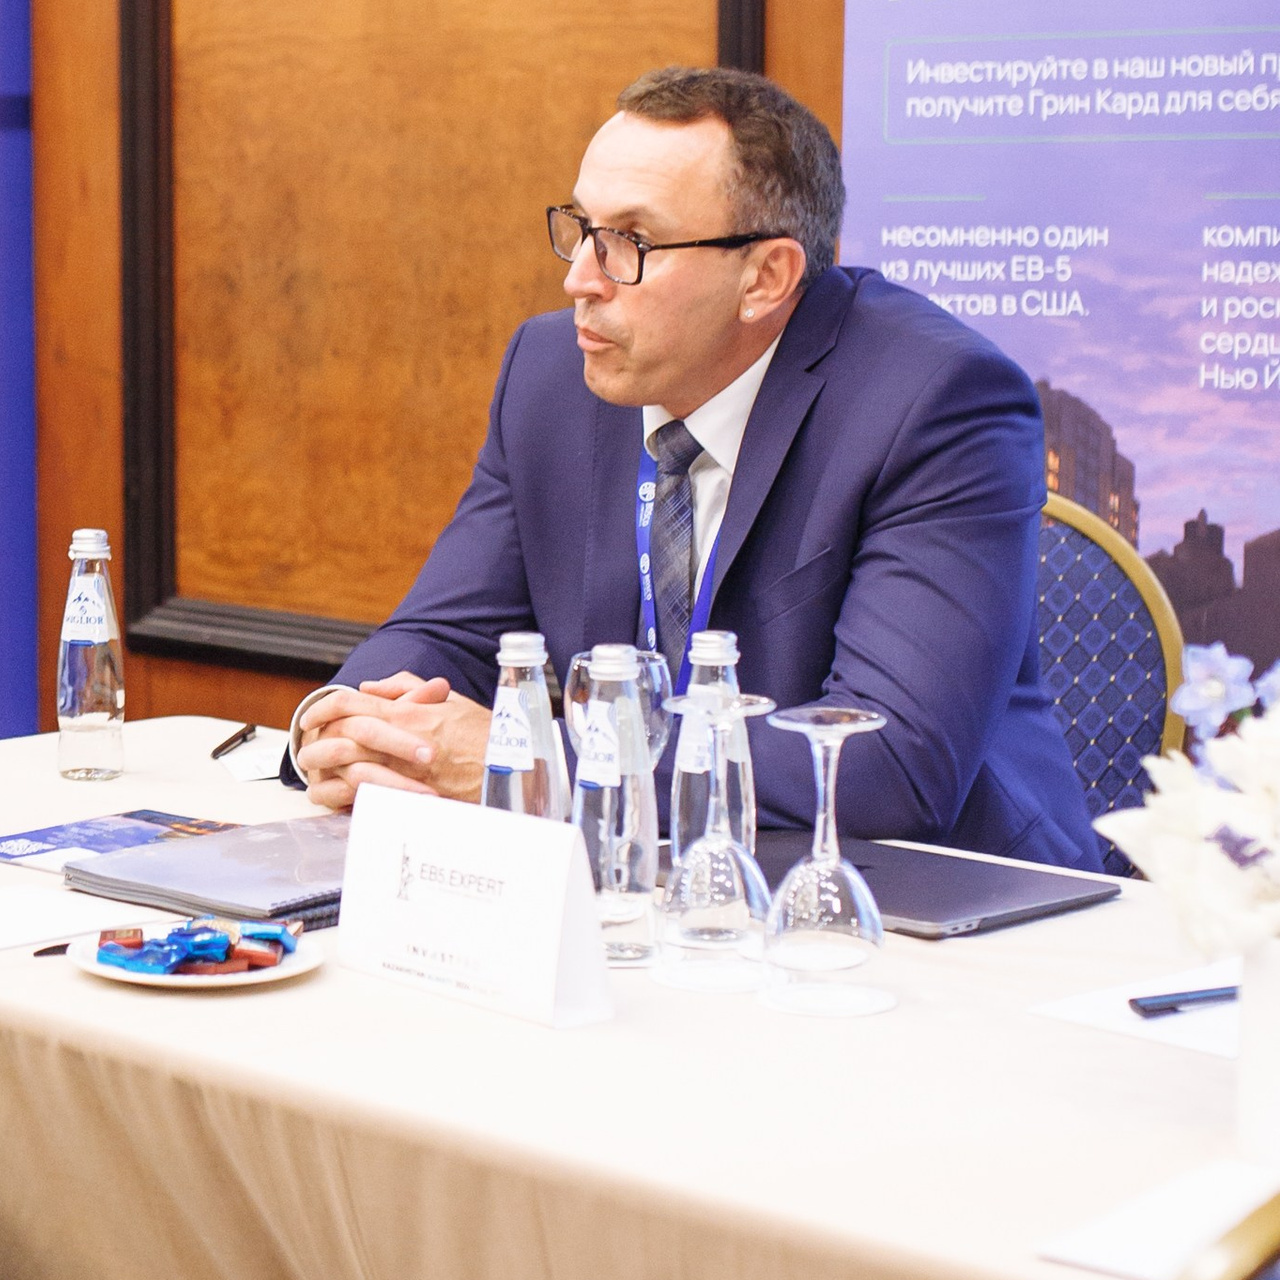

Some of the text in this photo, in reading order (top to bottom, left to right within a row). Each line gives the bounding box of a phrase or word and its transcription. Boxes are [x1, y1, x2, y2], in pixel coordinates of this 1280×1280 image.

[906, 55, 1089, 88] Инвестируйте
[1091, 57, 1109, 80] в
[1112, 57, 1166, 80] наш
[1169, 48, 1255, 77] новый
[906, 93, 1024, 124] получите
[1028, 88, 1091, 122] Грин
[1094, 87, 1161, 121] Кард
[1163, 87, 1213, 115] для
[880, 224, 1110, 251] несомненно один
[880, 259, 910, 282] из
[912, 259, 1007, 287] лучших
[1001, 294, 1018, 317] в
[1020, 288, 1090, 318] США.
[1201, 295, 1280, 325] и рос
[1198, 362, 1259, 391] Нью
[448, 869, 507, 898] EXPERT
